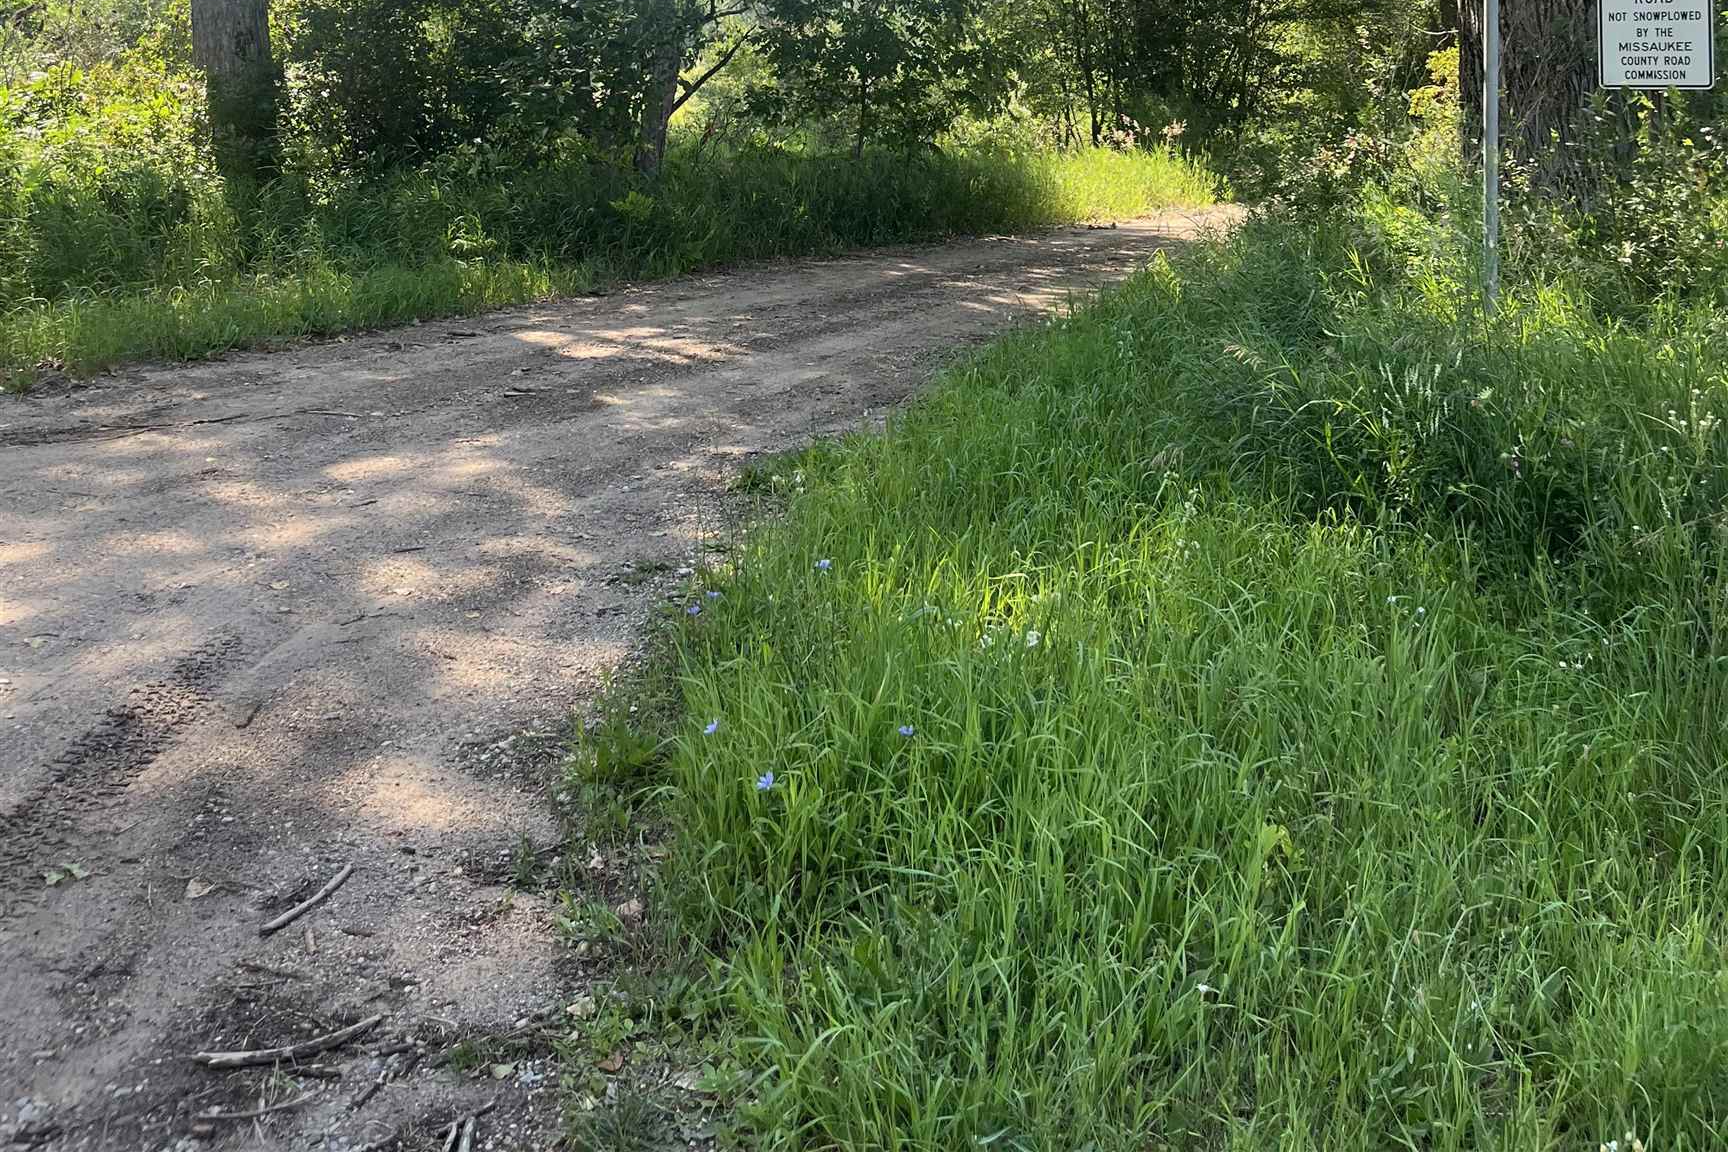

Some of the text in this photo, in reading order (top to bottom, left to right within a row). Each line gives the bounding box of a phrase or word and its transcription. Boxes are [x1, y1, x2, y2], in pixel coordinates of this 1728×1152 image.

[1608, 11, 1702, 22] NOT SNOWPLOWED
[1636, 27, 1673, 37] BY THE
[1618, 41, 1693, 52] MISSAUKEE
[1621, 56, 1691, 66] COUNTY ROAD
[1624, 70, 1686, 80] COMMISSION
